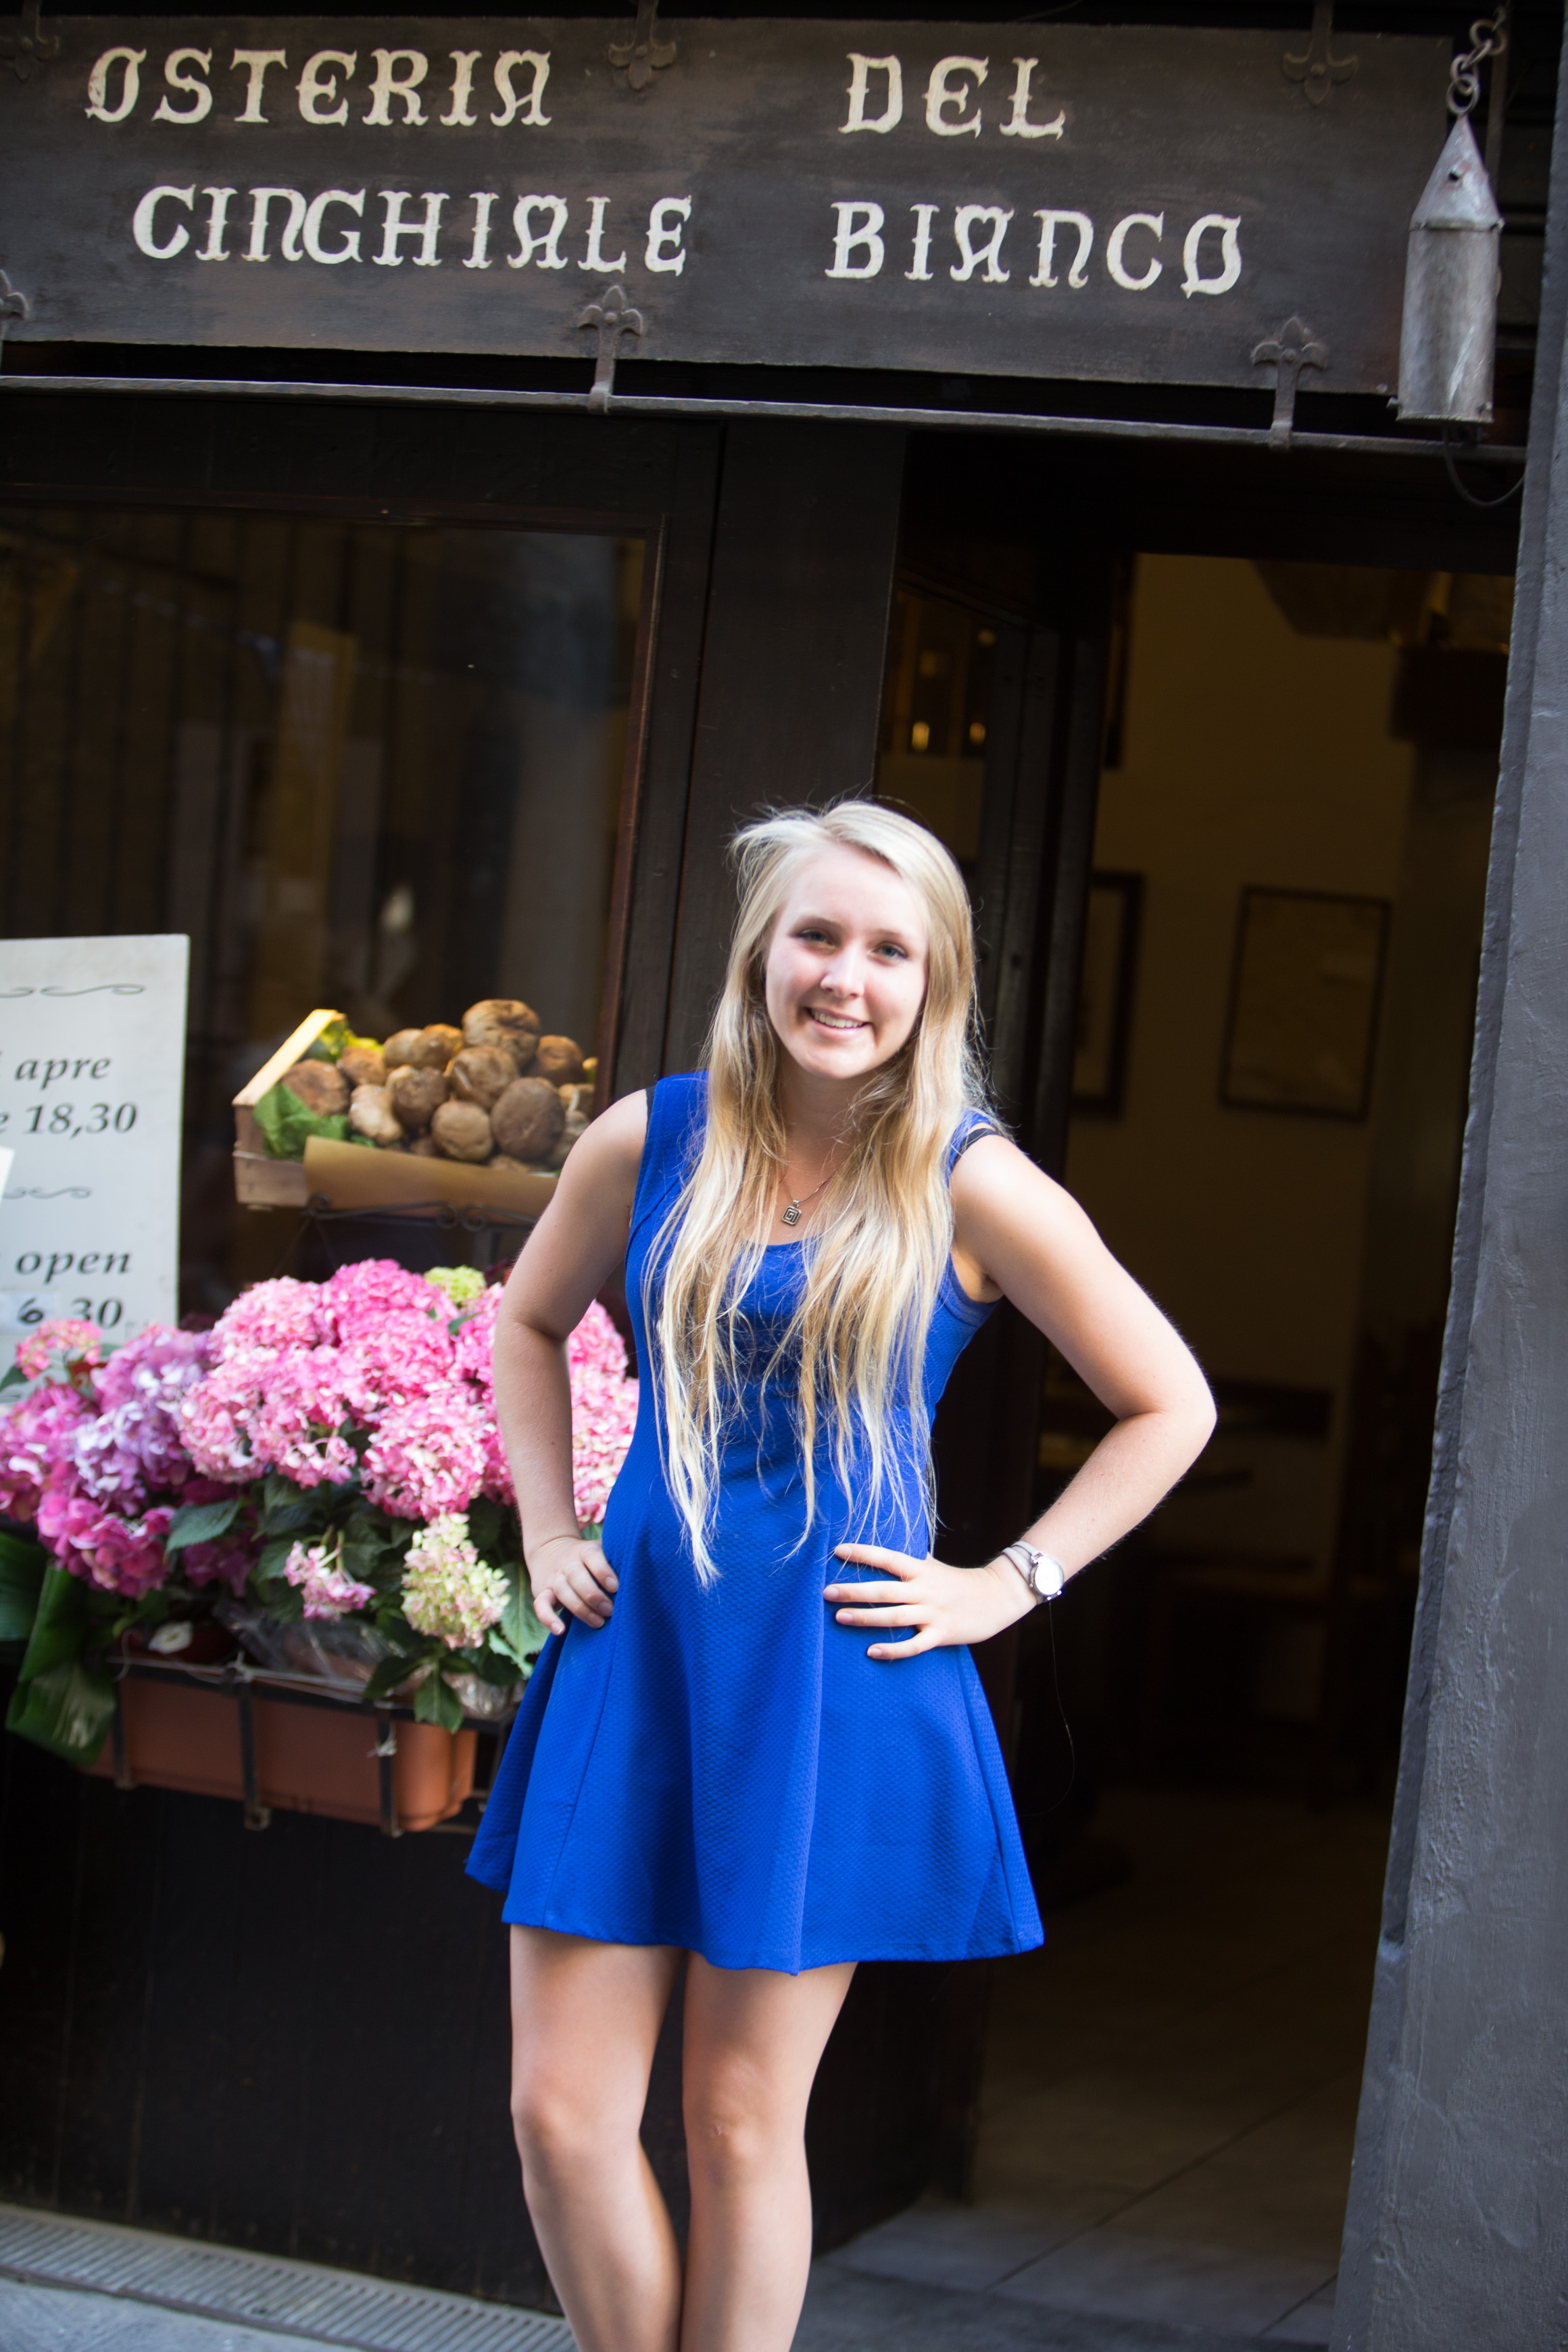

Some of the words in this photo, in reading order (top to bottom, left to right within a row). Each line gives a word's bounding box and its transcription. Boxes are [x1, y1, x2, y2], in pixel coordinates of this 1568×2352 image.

[84, 47, 553, 126] OSTERIA
[837, 53, 1067, 140] DEL
[132, 184, 693, 276] CINGHIALE
[824, 201, 1242, 299] BIANCO
[14, 1057, 111, 1091] apre
[24, 1102, 139, 1139] 18,30
[15, 1252, 131, 1285] open
